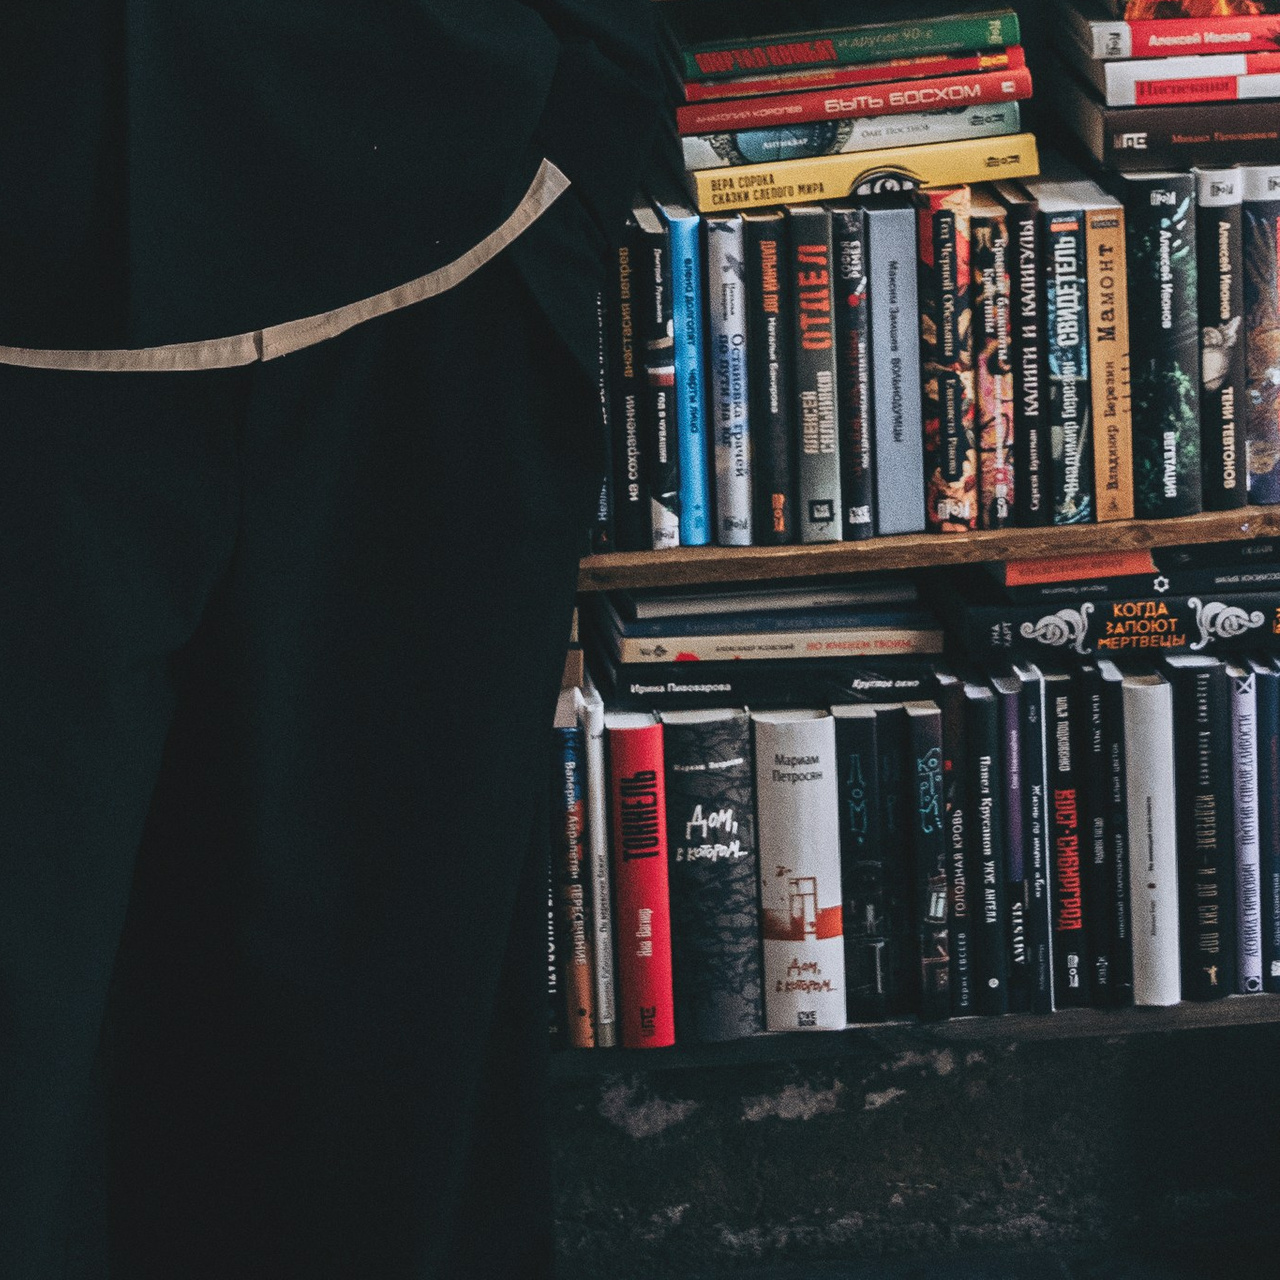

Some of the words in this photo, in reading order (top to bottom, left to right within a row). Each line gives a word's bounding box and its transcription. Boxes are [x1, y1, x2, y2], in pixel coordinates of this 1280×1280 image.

[824, 94, 883, 113] БЫТЬ
[890, 84, 982, 106] БОСХОМ
[797, 245, 832, 351] ОТДЕЛ
[1053, 235, 1079, 347] СВИДЕТЕЛЬ
[775, 754, 819, 768] Мариам
[772, 770, 822, 783] Петросян
